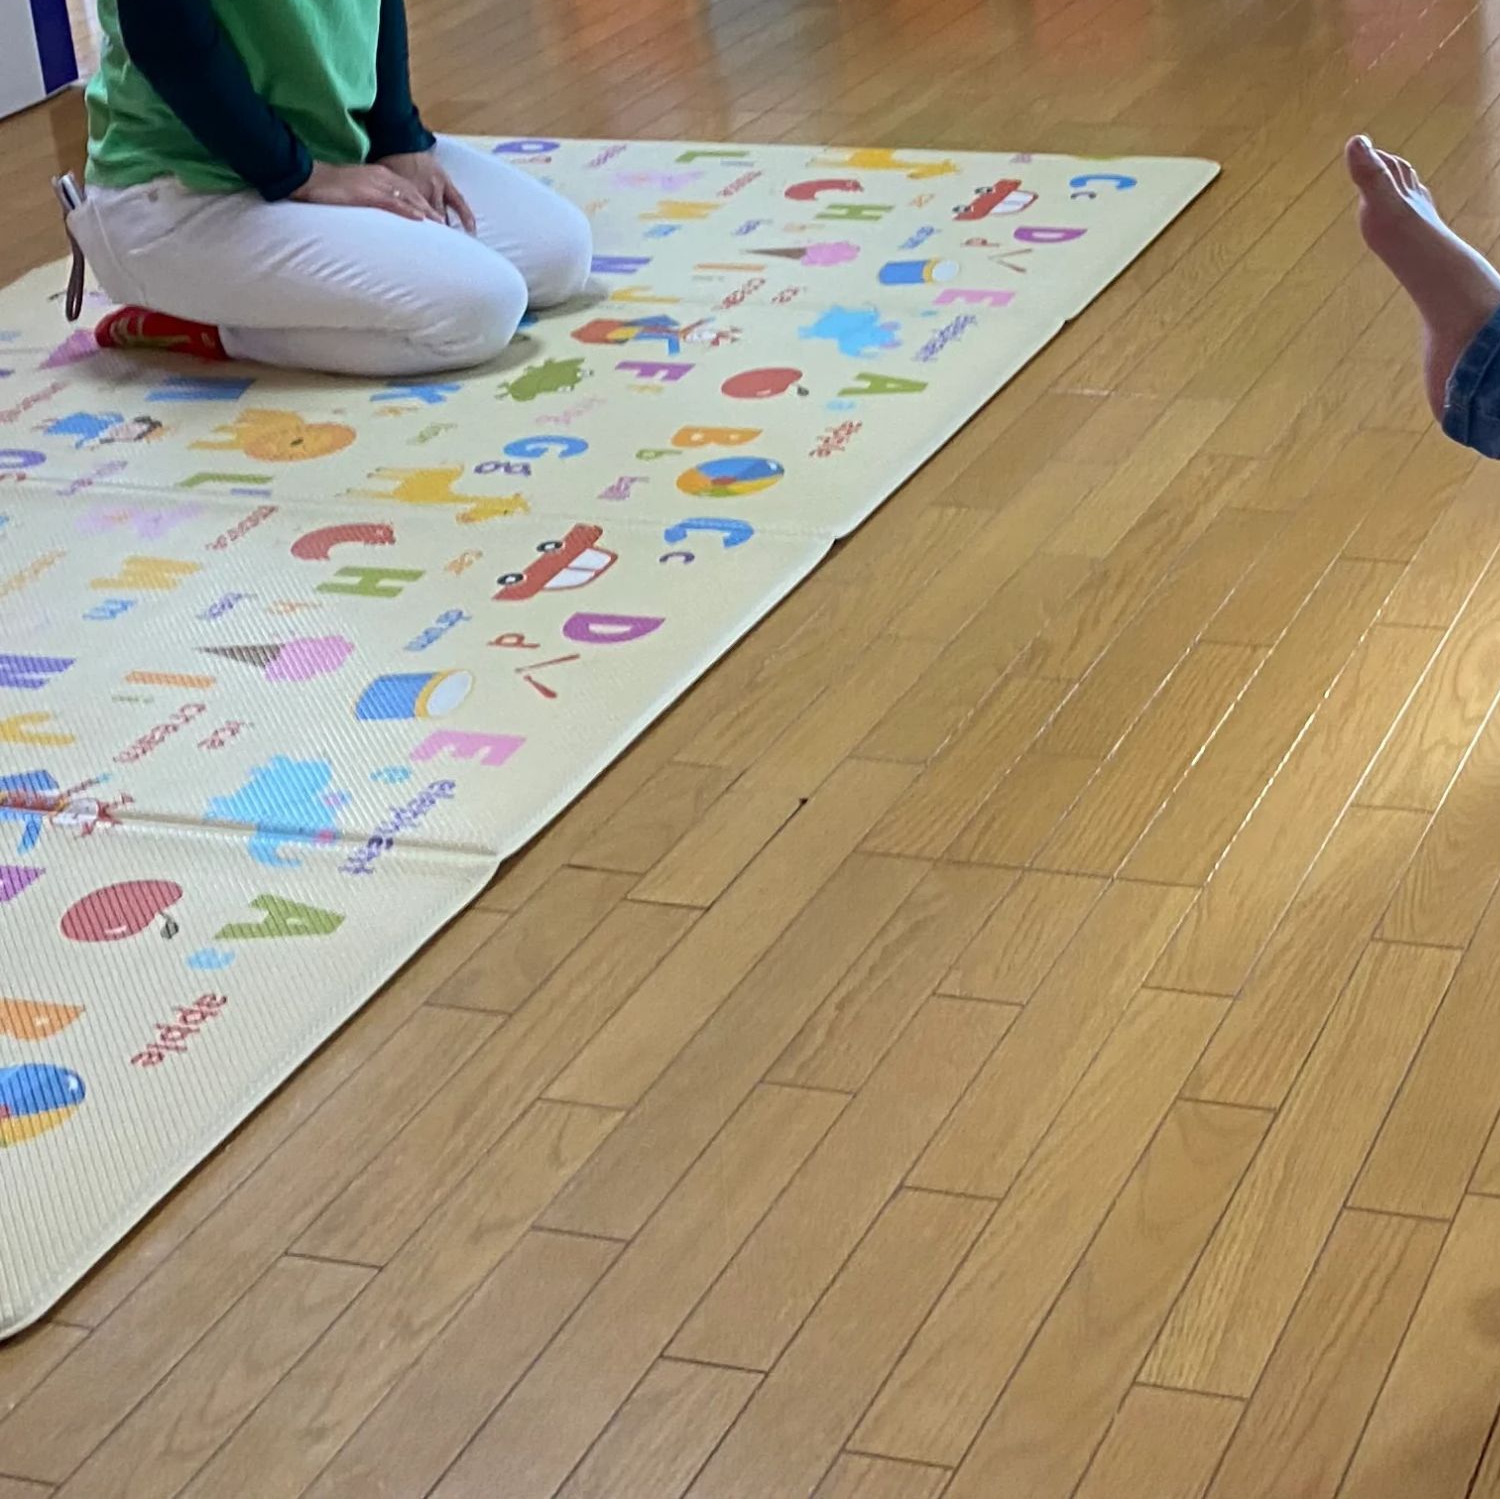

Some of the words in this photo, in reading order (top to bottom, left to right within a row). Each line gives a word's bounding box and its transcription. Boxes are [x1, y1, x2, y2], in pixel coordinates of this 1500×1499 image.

[675, 150, 748, 162] L
[1069, 174, 1137, 191] C
[1070, 190, 1097, 200] c
[815, 204, 895, 222] H
[1013, 227, 1086, 244] D
[932, 288, 1015, 307] E
[616, 361, 694, 382] F
[371, 376, 460, 404] K
[838, 372, 928, 396] A
[503, 435, 589, 459] G
[671, 426, 762, 449] B
[178, 472, 273, 488] L
[663, 517, 755, 548] C
[659, 551, 695, 564] c
[316, 566, 426, 598] H
[562, 612, 665, 644] D
[488, 633, 540, 649] d
[410, 729, 526, 767] E
[214, 894, 345, 941] A
[130, 992, 228, 1068] apple
